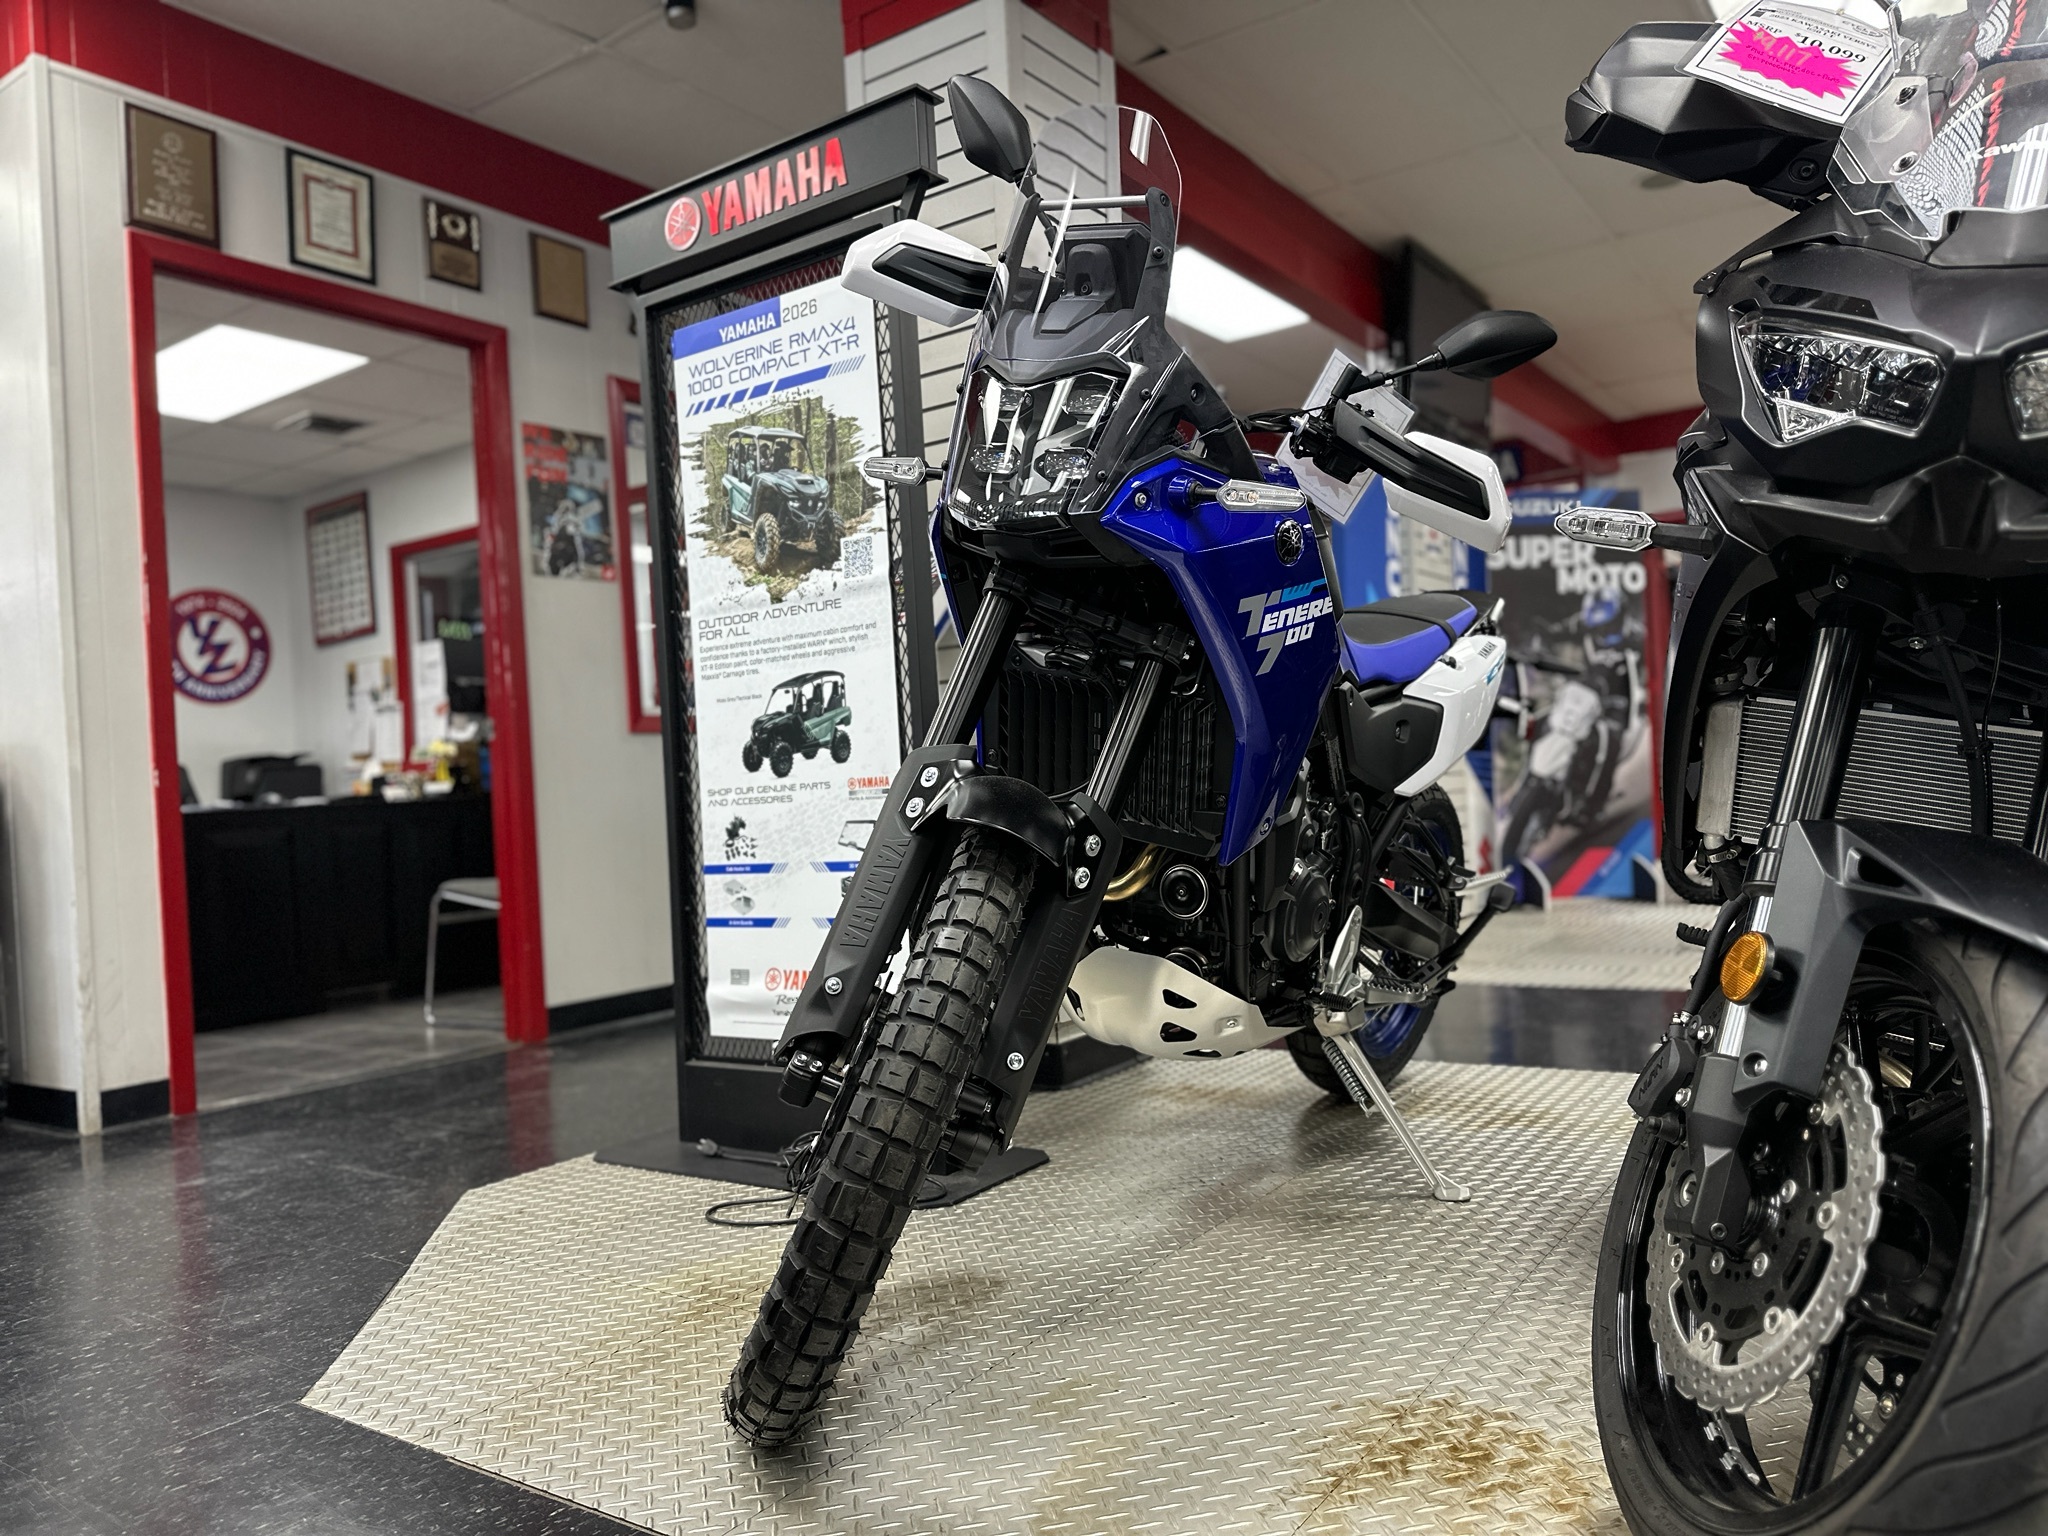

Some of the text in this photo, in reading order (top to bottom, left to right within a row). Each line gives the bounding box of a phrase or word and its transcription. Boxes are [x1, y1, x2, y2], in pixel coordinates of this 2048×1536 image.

[1746, 20, 1782, 34] MSRP
[1791, 17, 1841, 37] KAWASAKI
[701, 136, 848, 236] YAMAHA
[718, 298, 818, 343] YAMAHA 2026
[688, 315, 856, 379] WOLVERINE RMAX4
[687, 333, 860, 397] 1000 COMPACT XT-R
[1555, 562, 1647, 595] MOTO
[698, 598, 842, 630] OUTDOOR ADVENTURE
[699, 625, 750, 641] FOR ALL
[699, 621, 877, 654] Experience extreme adventure with maximum cabin comfort and
[700, 652, 729, 663] confidence
[729, 650, 749, 658] thanks
[760, 642, 806, 655] factory-installed
[848, 633, 869, 643] stylish
[1256, 621, 1316, 677] 700
[700, 664, 713, 672] XT-R
[714, 662, 733, 670] Edition
[749, 654, 790, 666] color-matched
[791, 651, 811, 660] wheels
[811, 649, 823, 657] and
[823, 644, 856, 656] aggressive
[1477, 640, 1498, 660] YAMAHA
[707, 781, 831, 797] SHOP OUR GENUINE PARTS
[857, 776, 890, 789] YAMAHA
[707, 795, 794, 807] AND ACCESSORIES
[840, 838, 912, 948] YAMAHA
[1017, 907, 1084, 1024] YAMAHA
